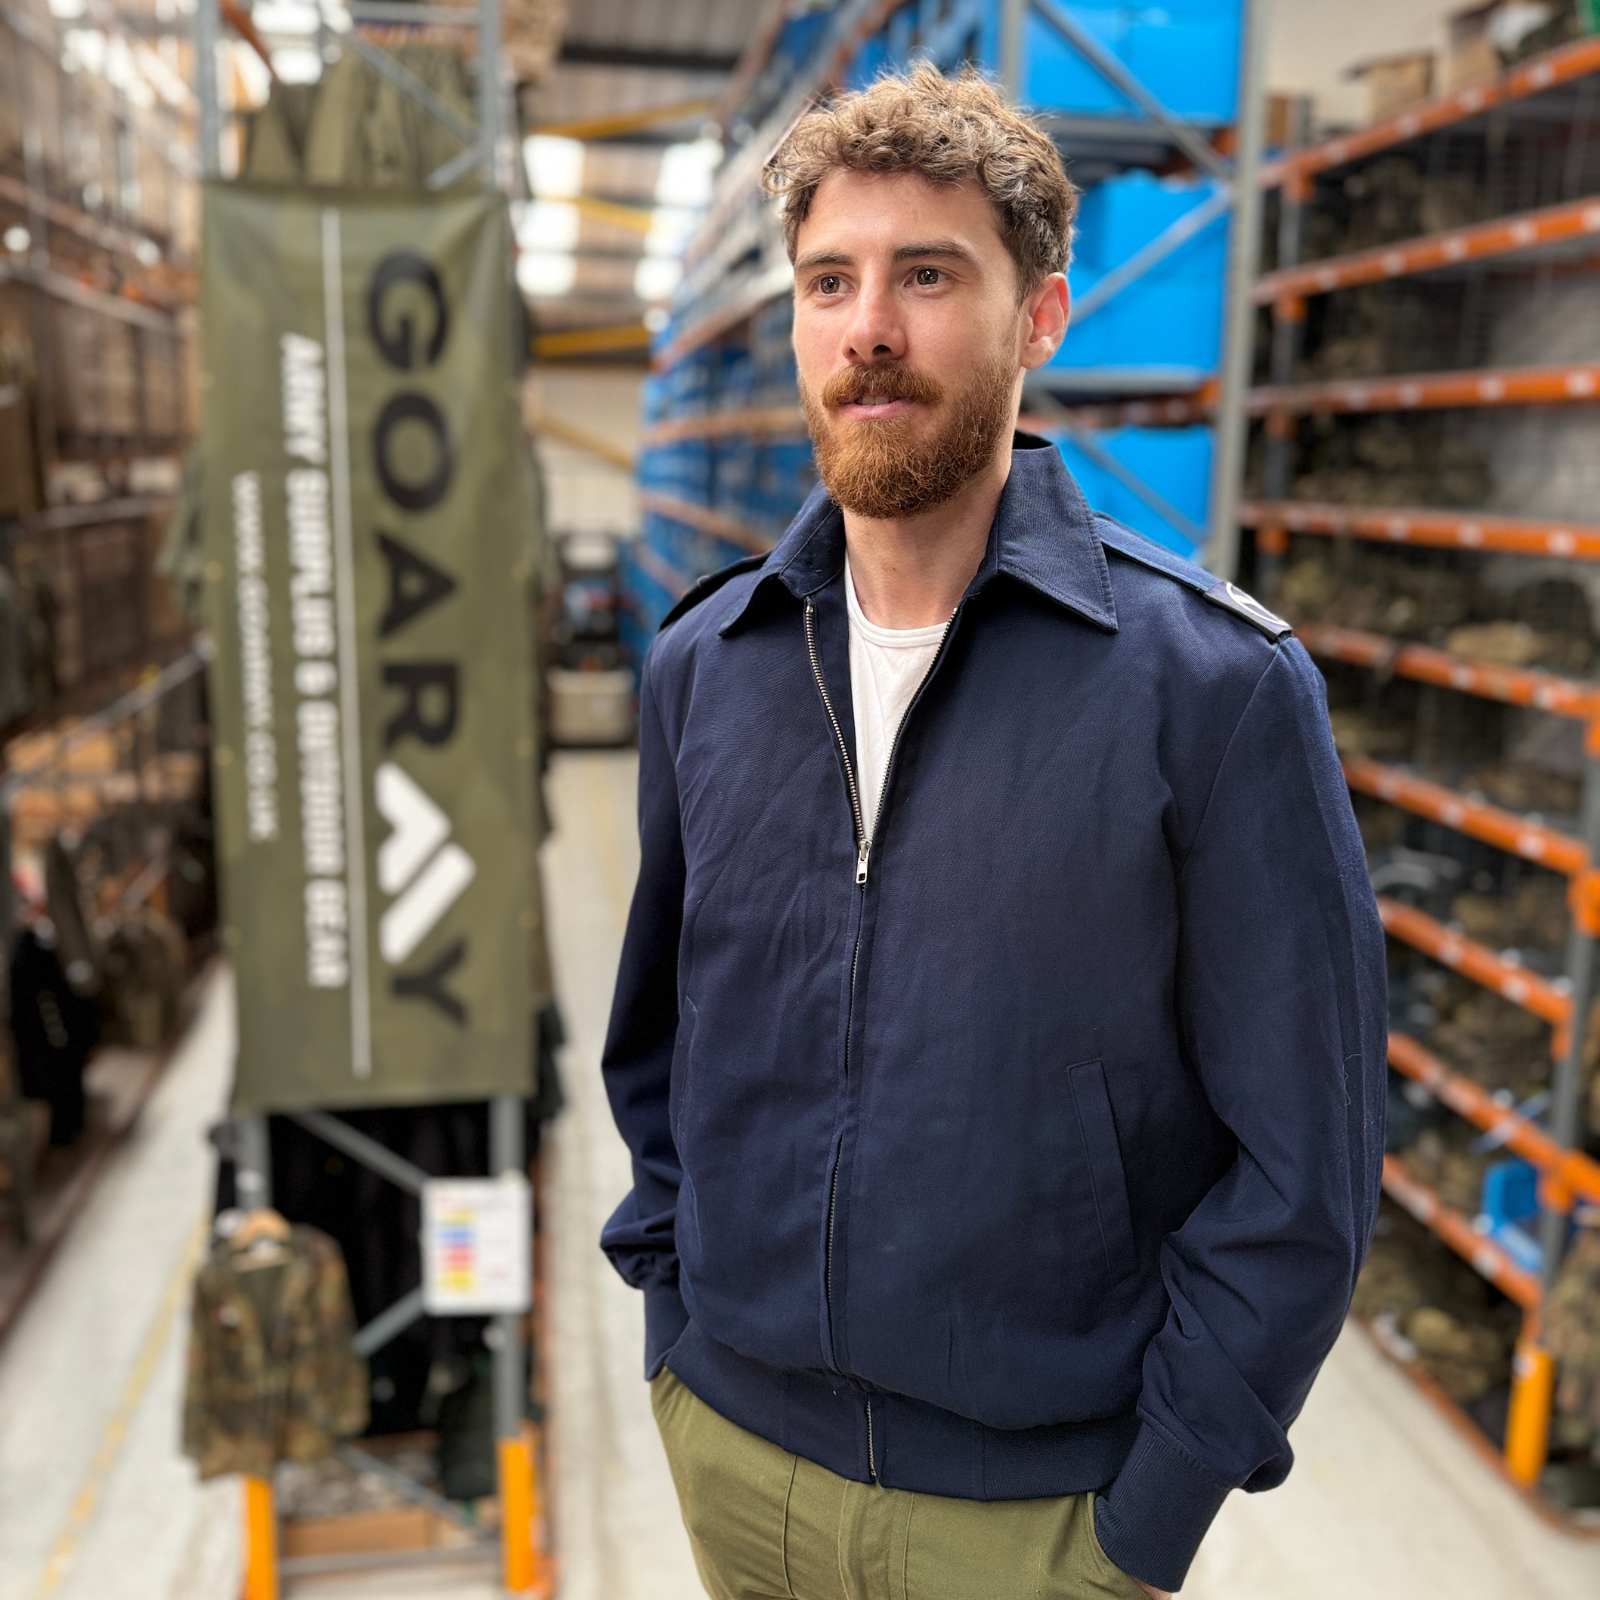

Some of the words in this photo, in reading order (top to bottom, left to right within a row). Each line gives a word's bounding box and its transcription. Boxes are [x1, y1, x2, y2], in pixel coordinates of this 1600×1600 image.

[281, 333, 325, 464] ARMY
[287, 468, 335, 656] SURPLUS
[305, 879, 348, 986] GEAR
